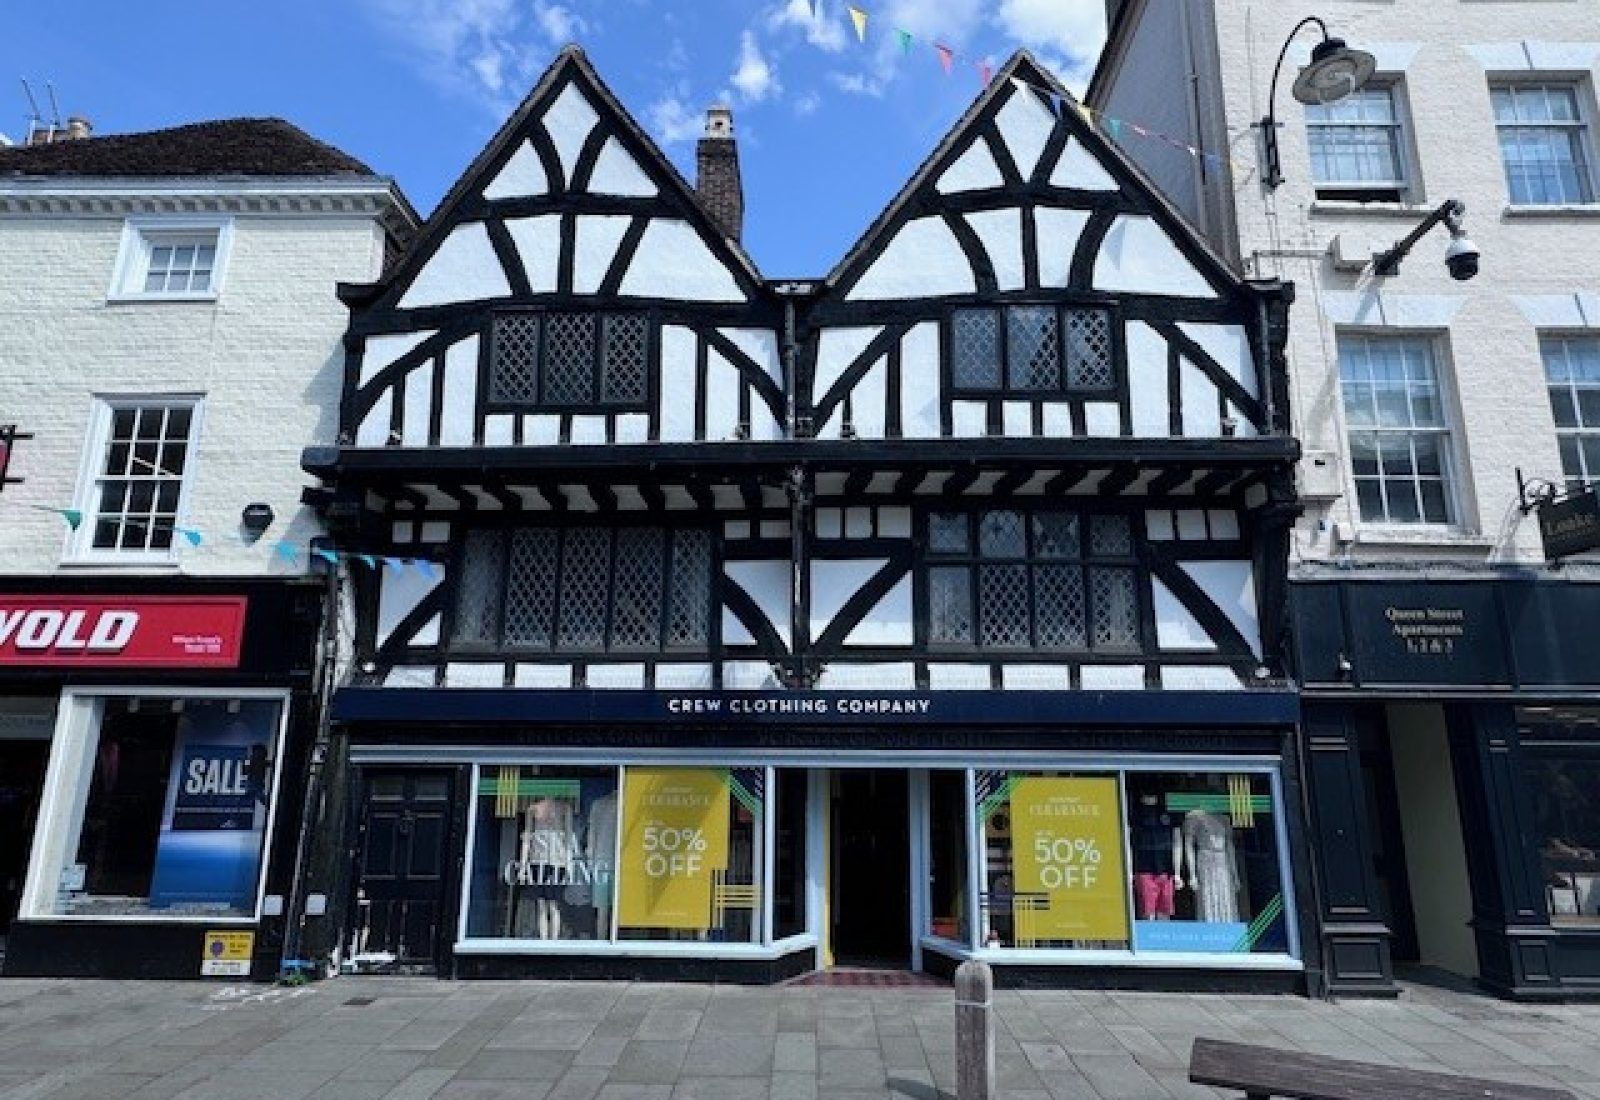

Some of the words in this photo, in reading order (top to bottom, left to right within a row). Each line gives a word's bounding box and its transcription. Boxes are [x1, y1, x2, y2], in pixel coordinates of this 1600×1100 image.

[1384, 607, 1425, 622] Queen
[1427, 608, 1463, 620] Street
[1392, 624, 1463, 638] Apartments
[669, 699, 721, 713] CREW
[729, 699, 828, 713] CLOTHING
[836, 699, 931, 713] COMPANY
[185, 757, 250, 795] SALE
[643, 827, 708, 851] 50%
[1034, 838, 1101, 864] 50%
[504, 860, 609, 886] CALLING
[644, 852, 703, 878] OFF
[1039, 865, 1098, 888] OFF
